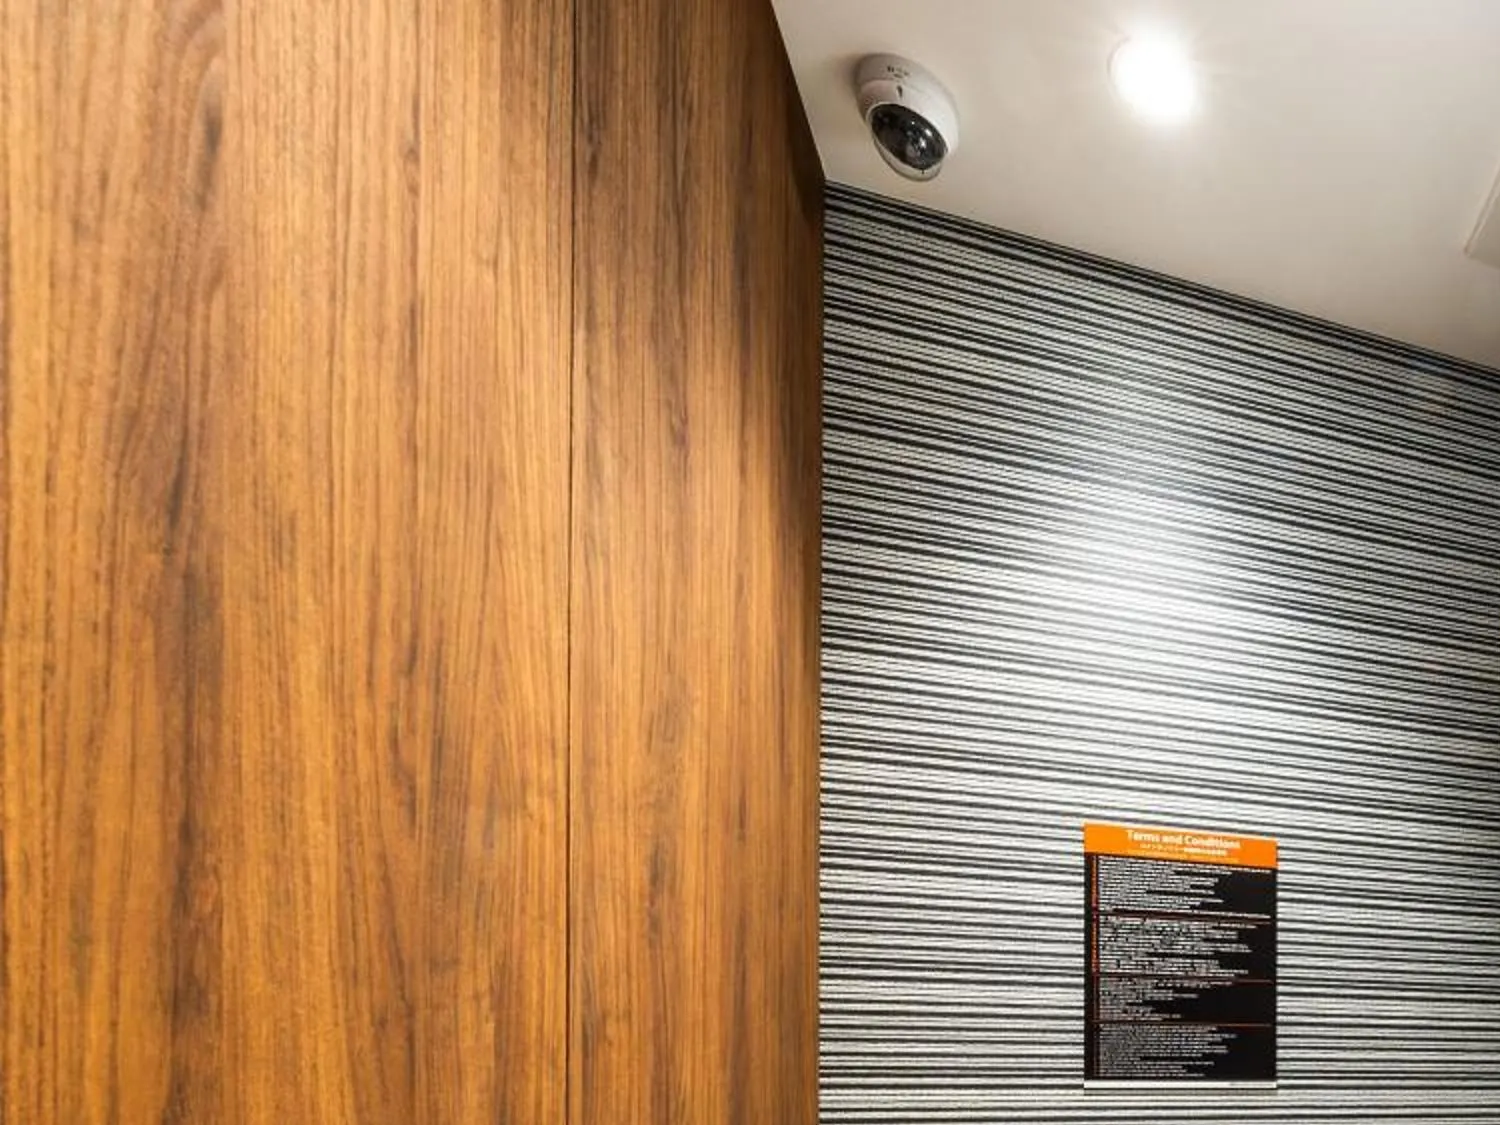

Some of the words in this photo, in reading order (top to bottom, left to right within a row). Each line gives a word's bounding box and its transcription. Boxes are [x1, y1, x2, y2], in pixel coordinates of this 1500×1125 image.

[1125, 829, 1160, 843] Terms
[1162, 832, 1184, 845] and
[1184, 834, 1241, 849] Conditions
